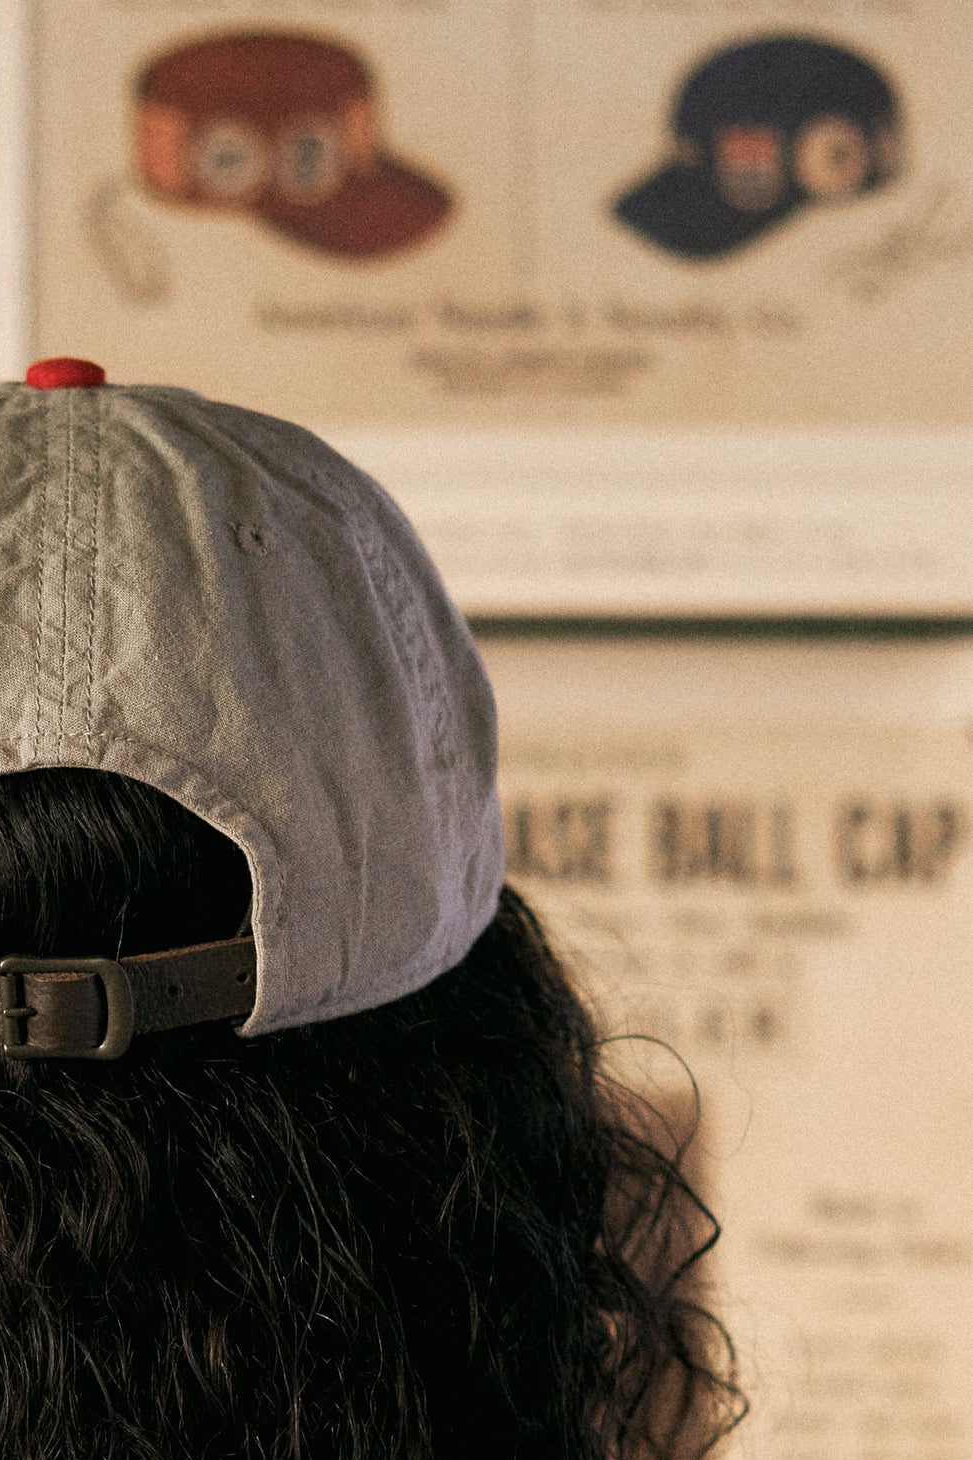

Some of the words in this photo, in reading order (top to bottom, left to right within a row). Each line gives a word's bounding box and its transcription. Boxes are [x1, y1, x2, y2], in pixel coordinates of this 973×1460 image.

[505, 797, 621, 887] ASE
[653, 797, 803, 887] BALL
[838, 797, 964, 887] CAP
